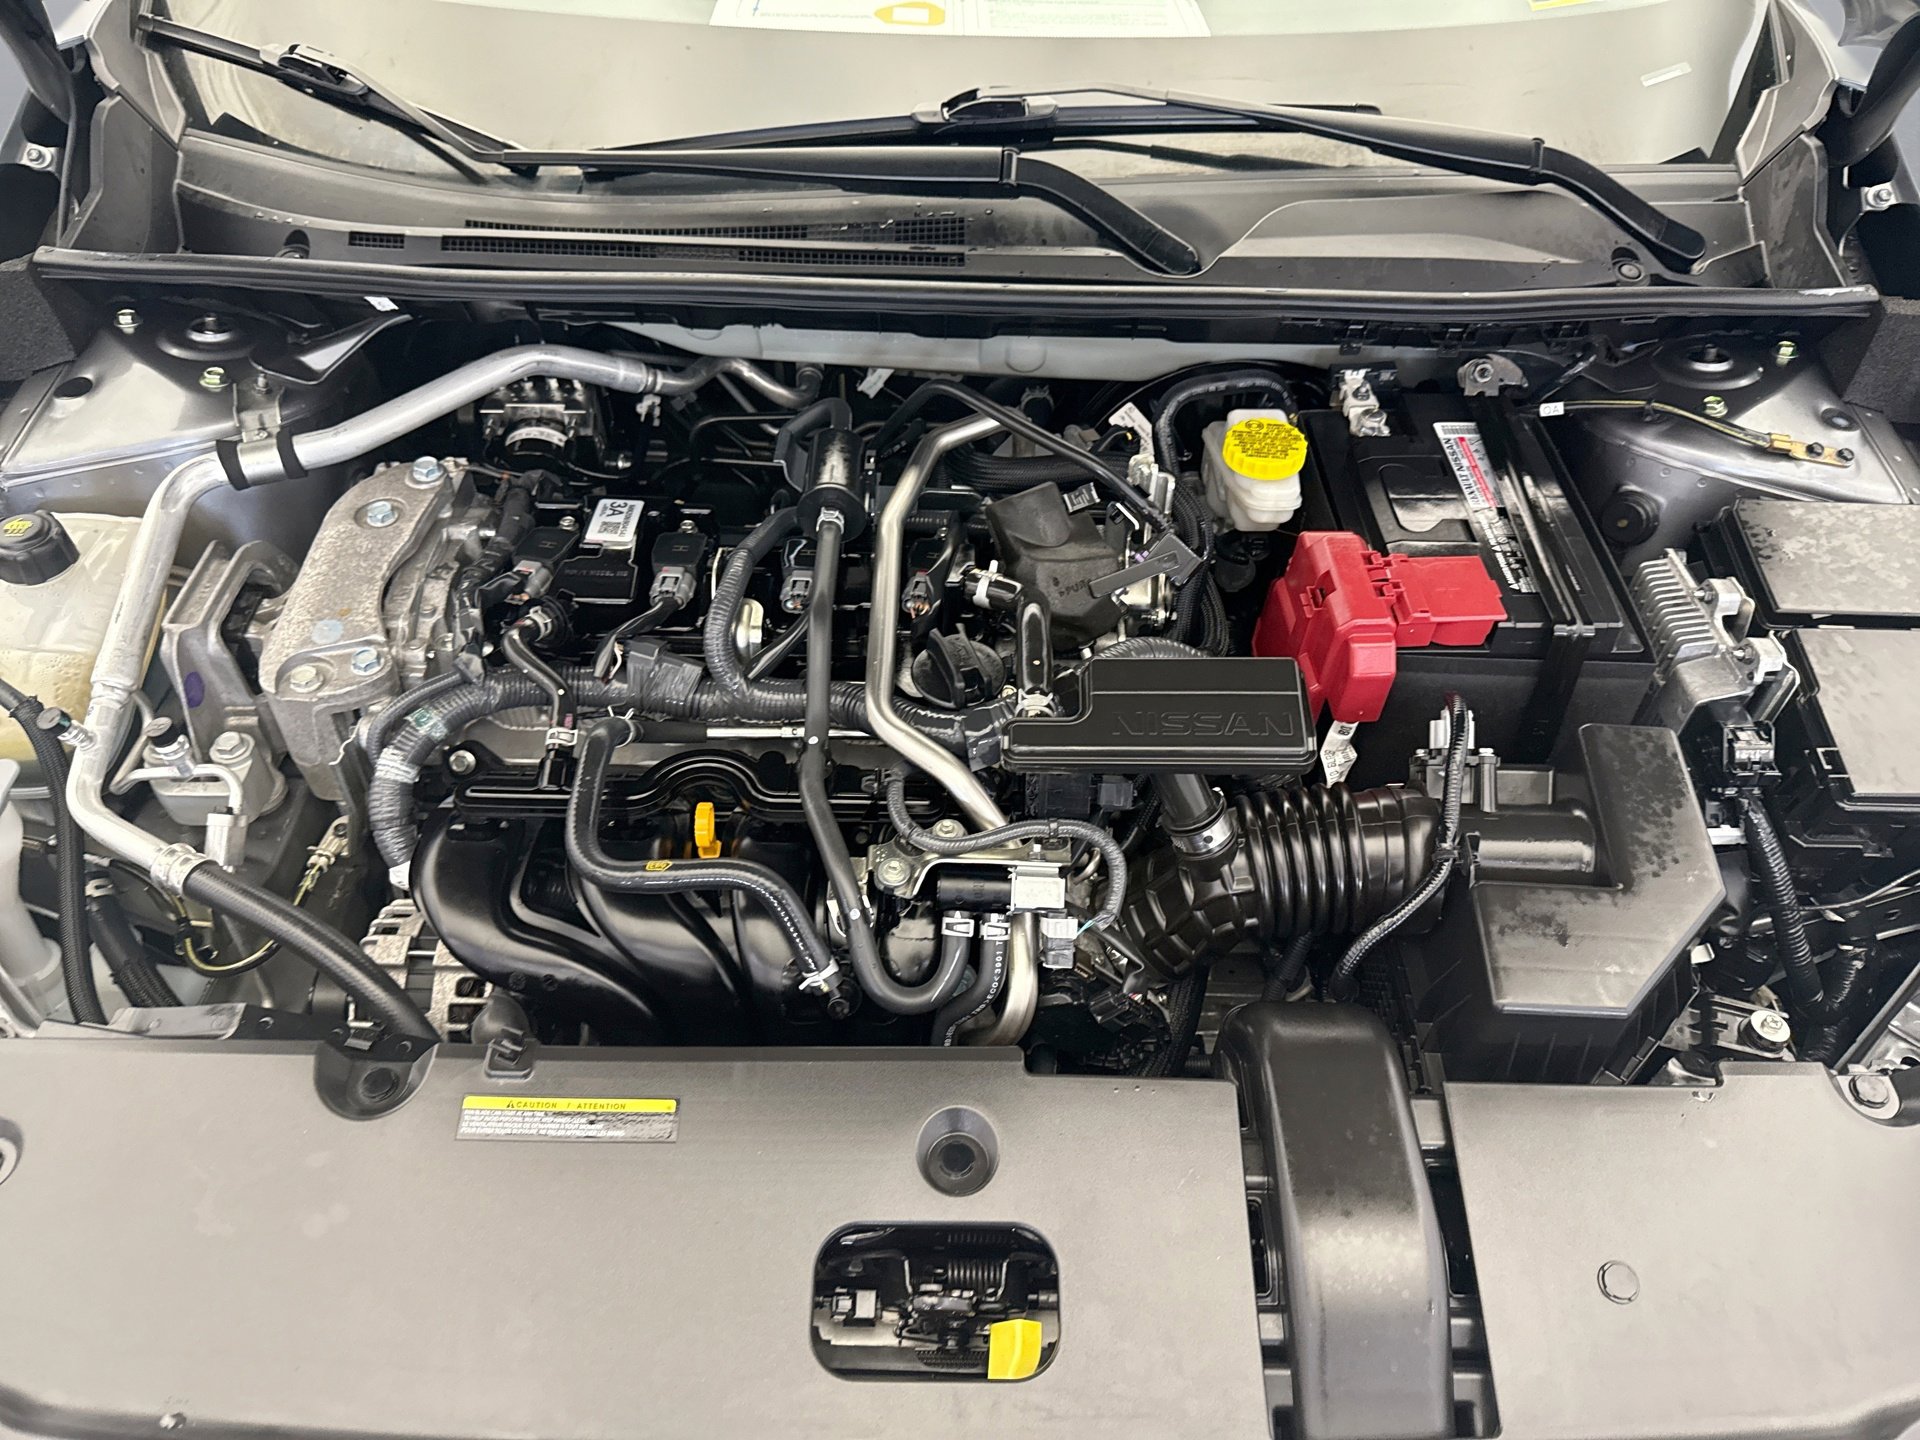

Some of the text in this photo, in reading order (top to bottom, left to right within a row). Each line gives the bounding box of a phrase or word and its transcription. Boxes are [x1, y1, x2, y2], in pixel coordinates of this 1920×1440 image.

[1442, 436, 1464, 472] NISSAN
[1458, 471, 1480, 506] RENAULT
[606, 501, 628, 517] 3A
[1112, 711, 1295, 736] NISSAN
[516, 1101, 557, 1109] CAUTION
[577, 1102, 627, 1110] ATTENTION
